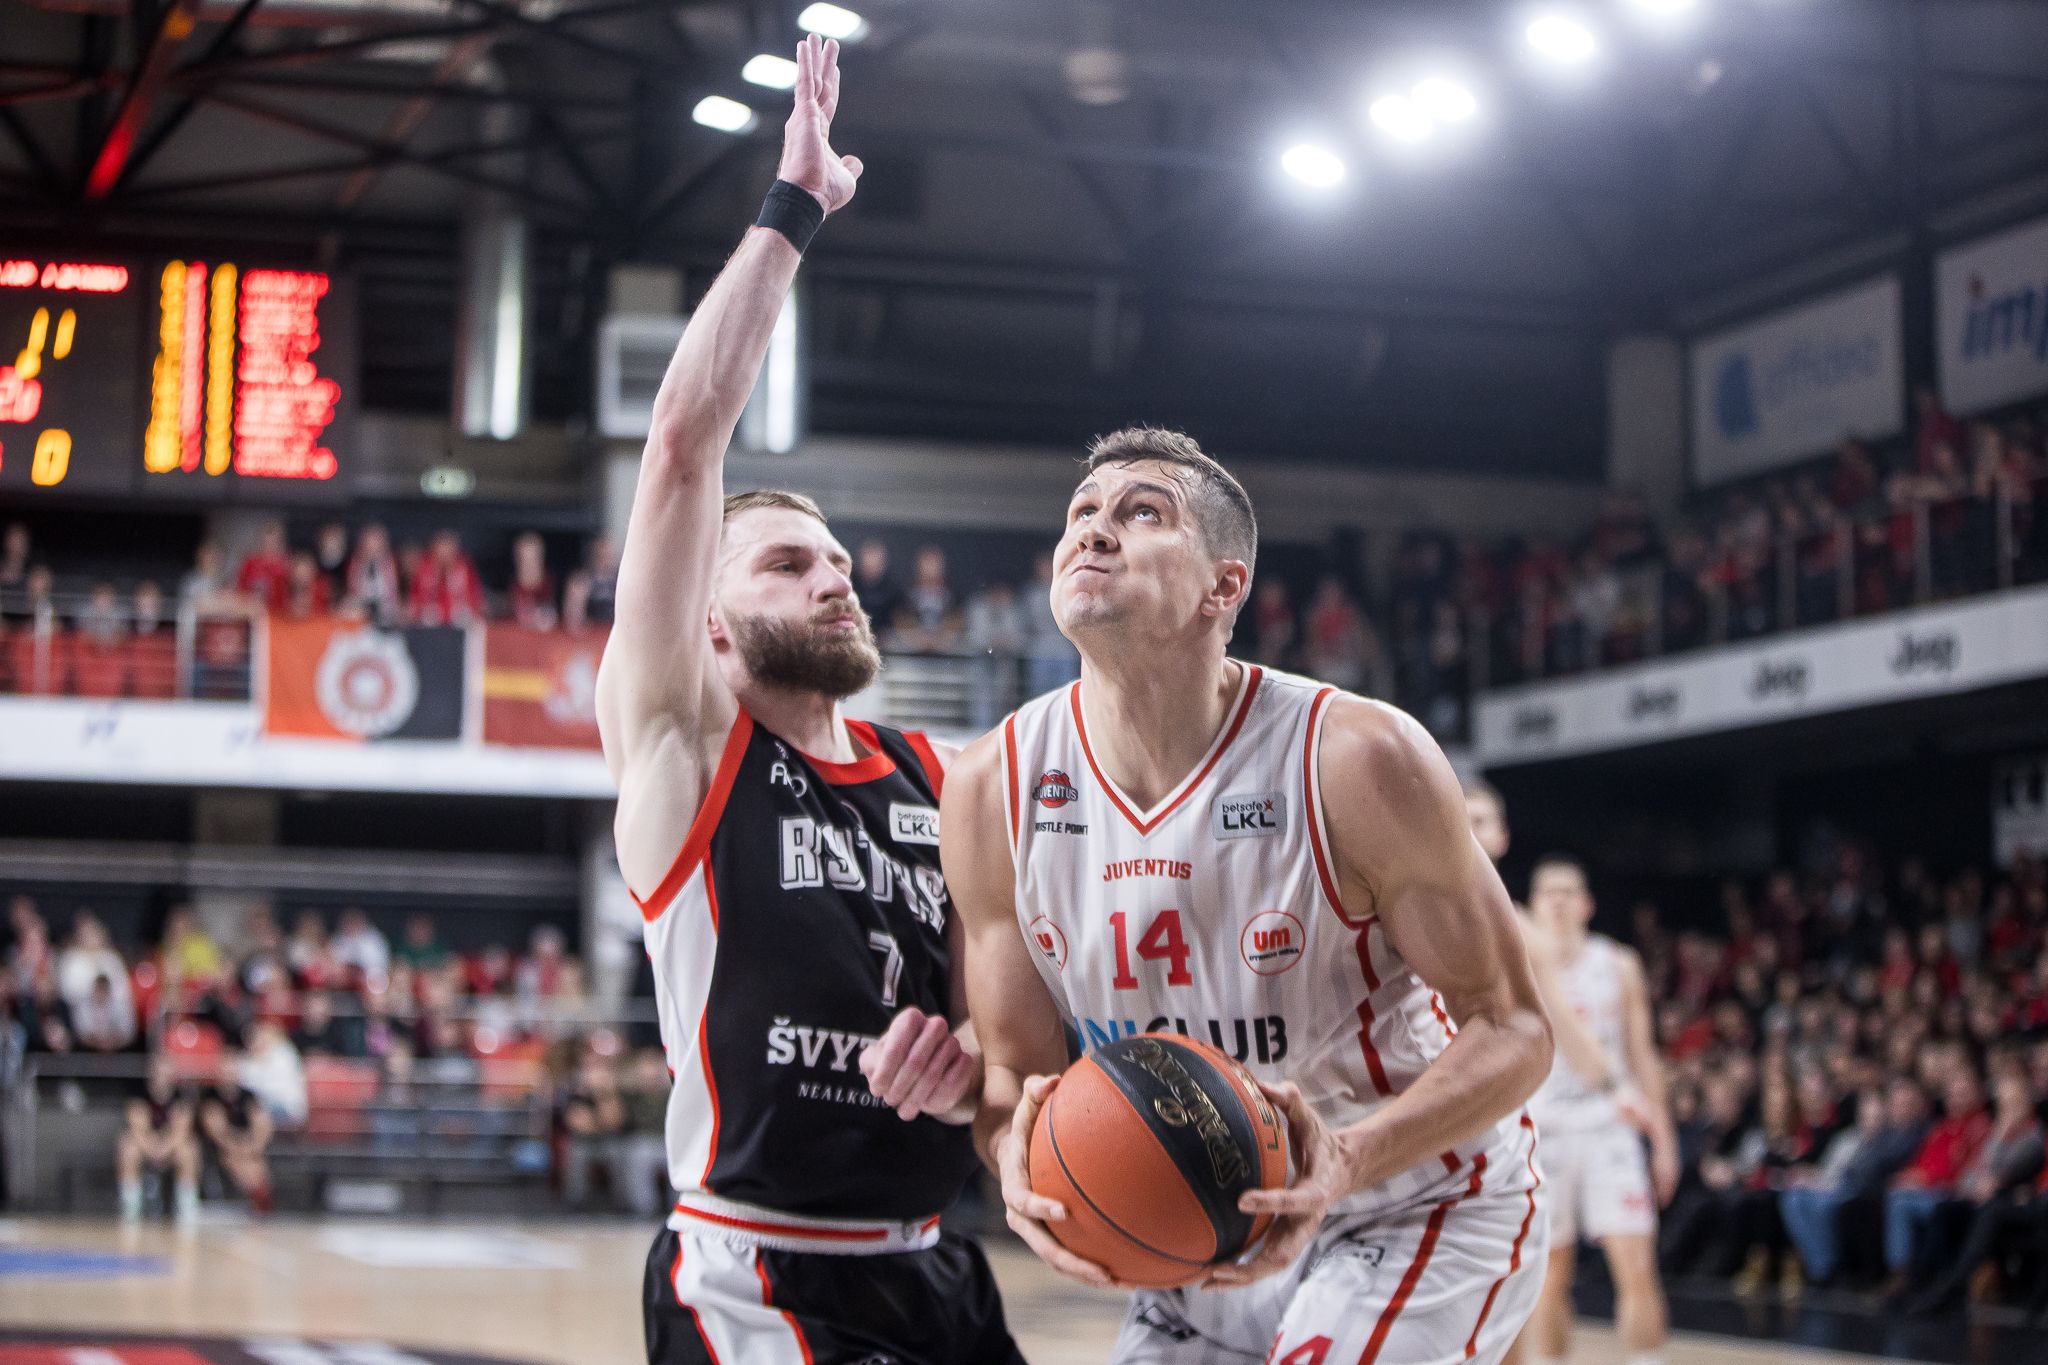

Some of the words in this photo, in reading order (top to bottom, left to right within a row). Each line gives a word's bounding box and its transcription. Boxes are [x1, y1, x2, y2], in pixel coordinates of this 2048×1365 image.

[1222, 800, 1264, 814] betsafe
[898, 820, 940, 838] LKL
[1223, 812, 1276, 831] LKL
[1103, 858, 1193, 882] JUVENTUS
[1109, 909, 1193, 990] 14
[868, 930, 904, 1008] 7
[767, 1015, 881, 1075] ŠVY
